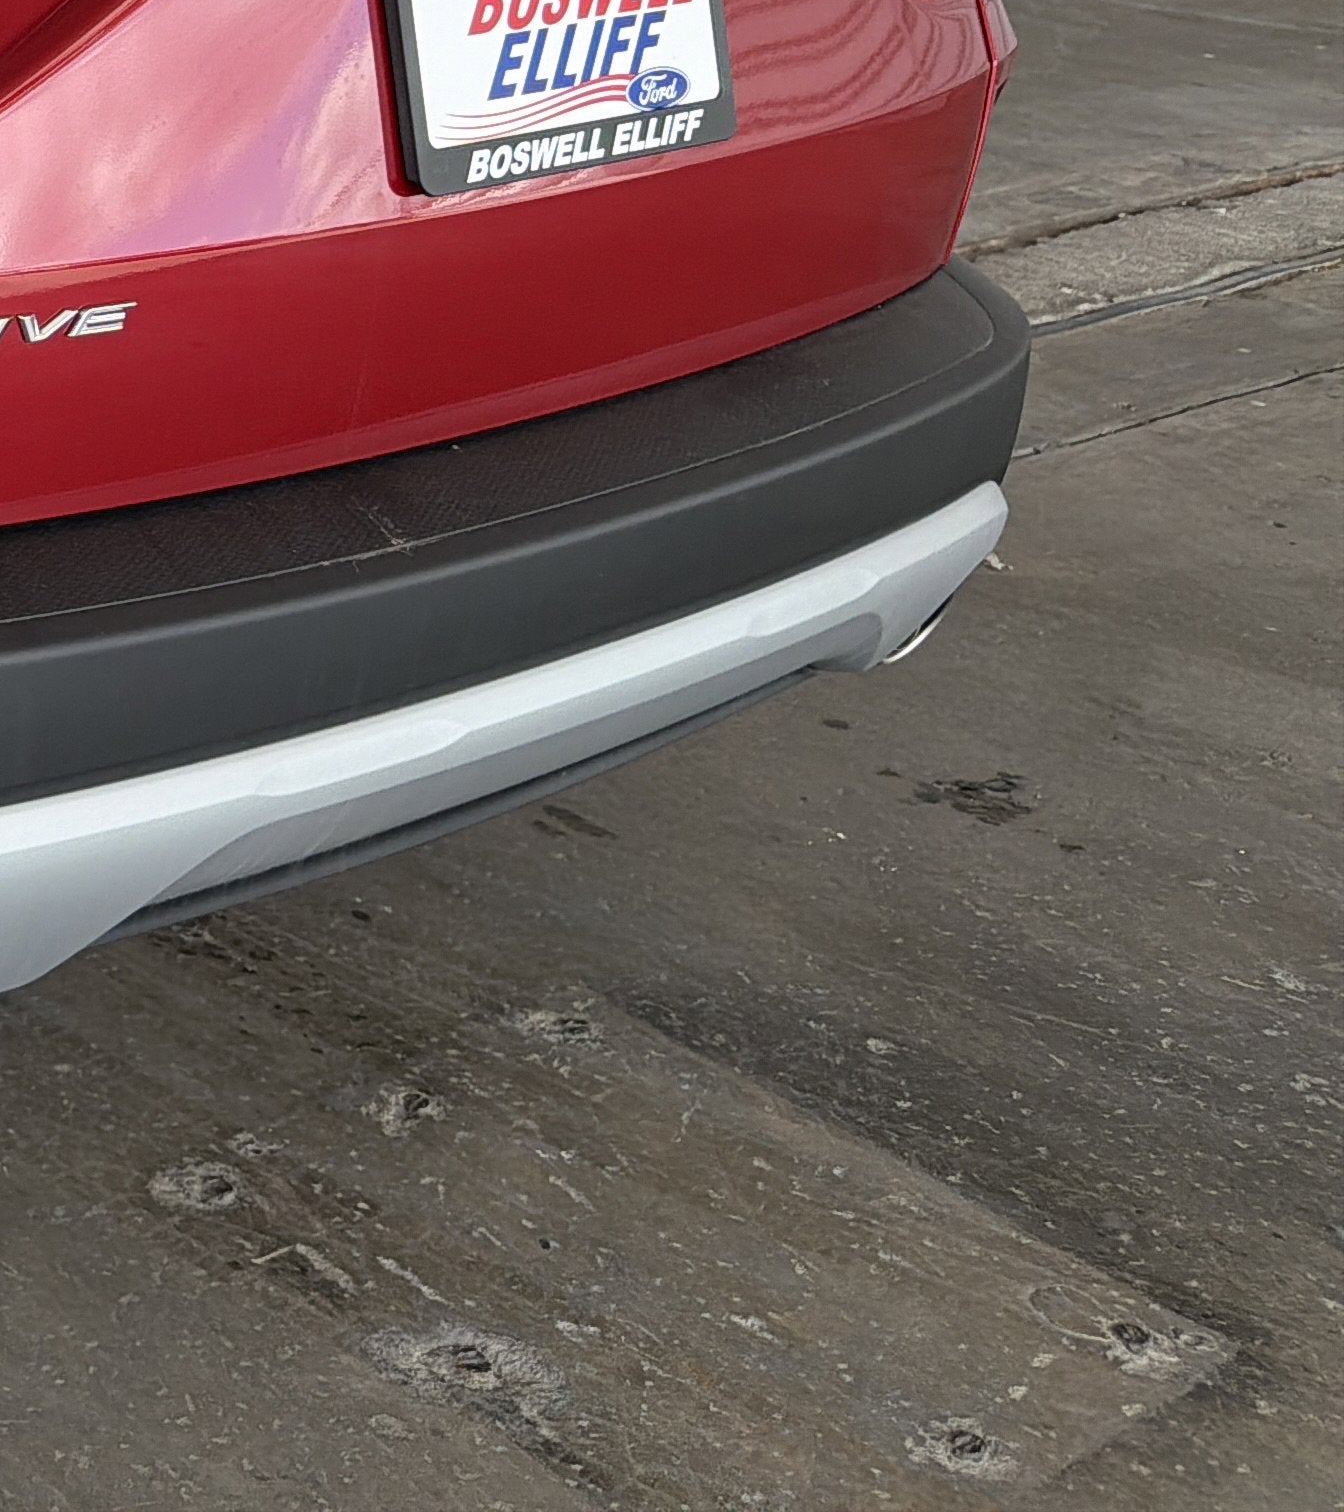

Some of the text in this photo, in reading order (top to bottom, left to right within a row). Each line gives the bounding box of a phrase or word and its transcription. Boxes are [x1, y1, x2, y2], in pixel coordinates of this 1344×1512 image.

[487, 9, 667, 101] ELLIFF
[638, 75, 678, 106] Ford
[466, 109, 705, 184] BOSWELL ELLIFF
